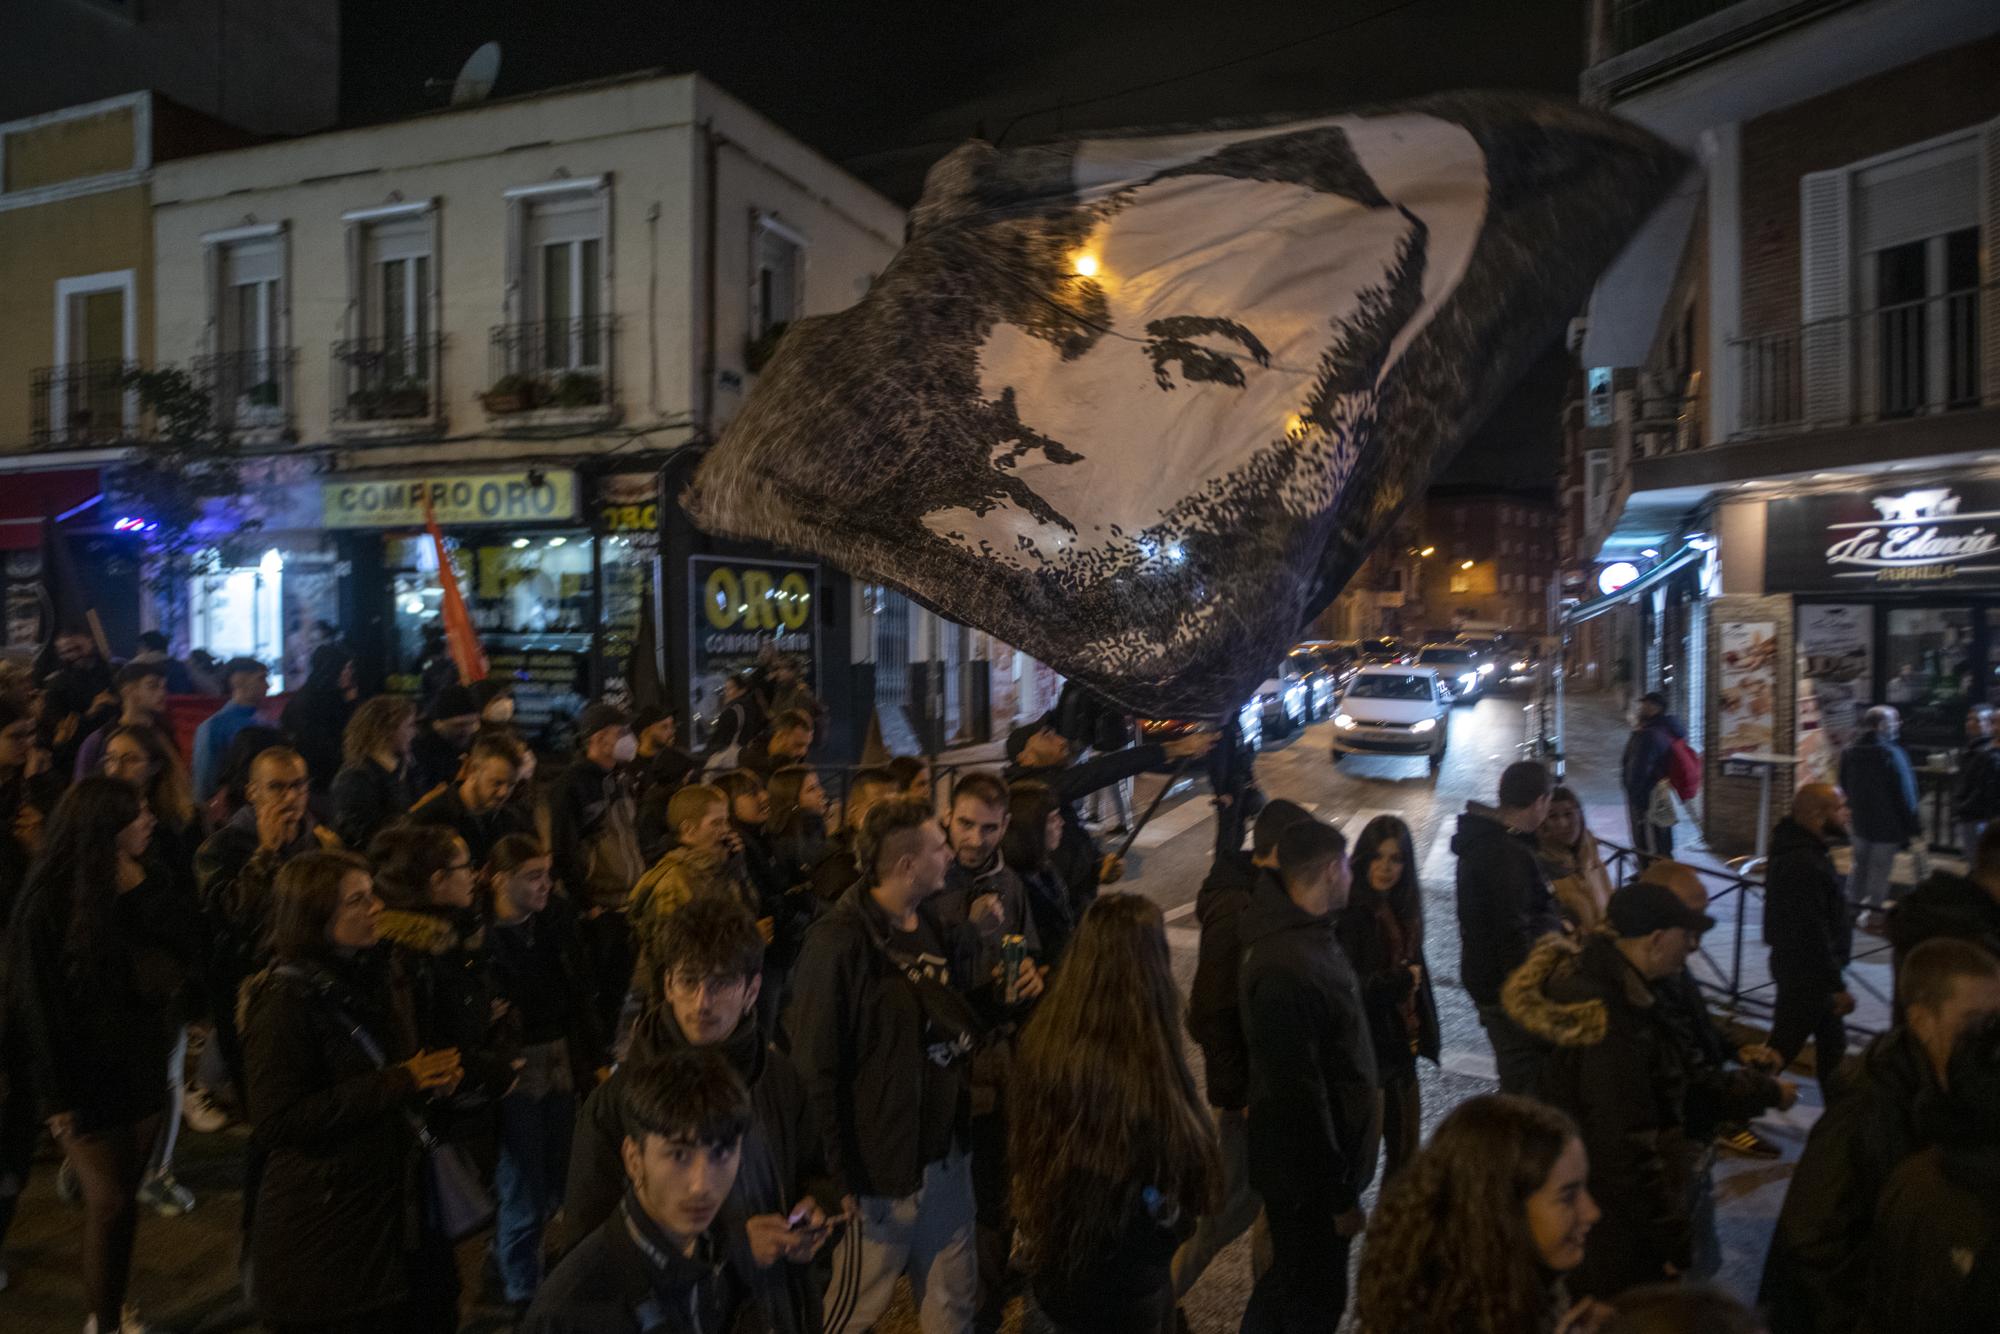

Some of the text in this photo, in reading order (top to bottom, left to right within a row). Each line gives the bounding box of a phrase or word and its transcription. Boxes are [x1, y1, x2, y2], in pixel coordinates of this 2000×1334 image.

[340, 479, 557, 516] COMPRO ORO
[1825, 528, 1880, 564] La
[705, 567, 810, 630] ORO
